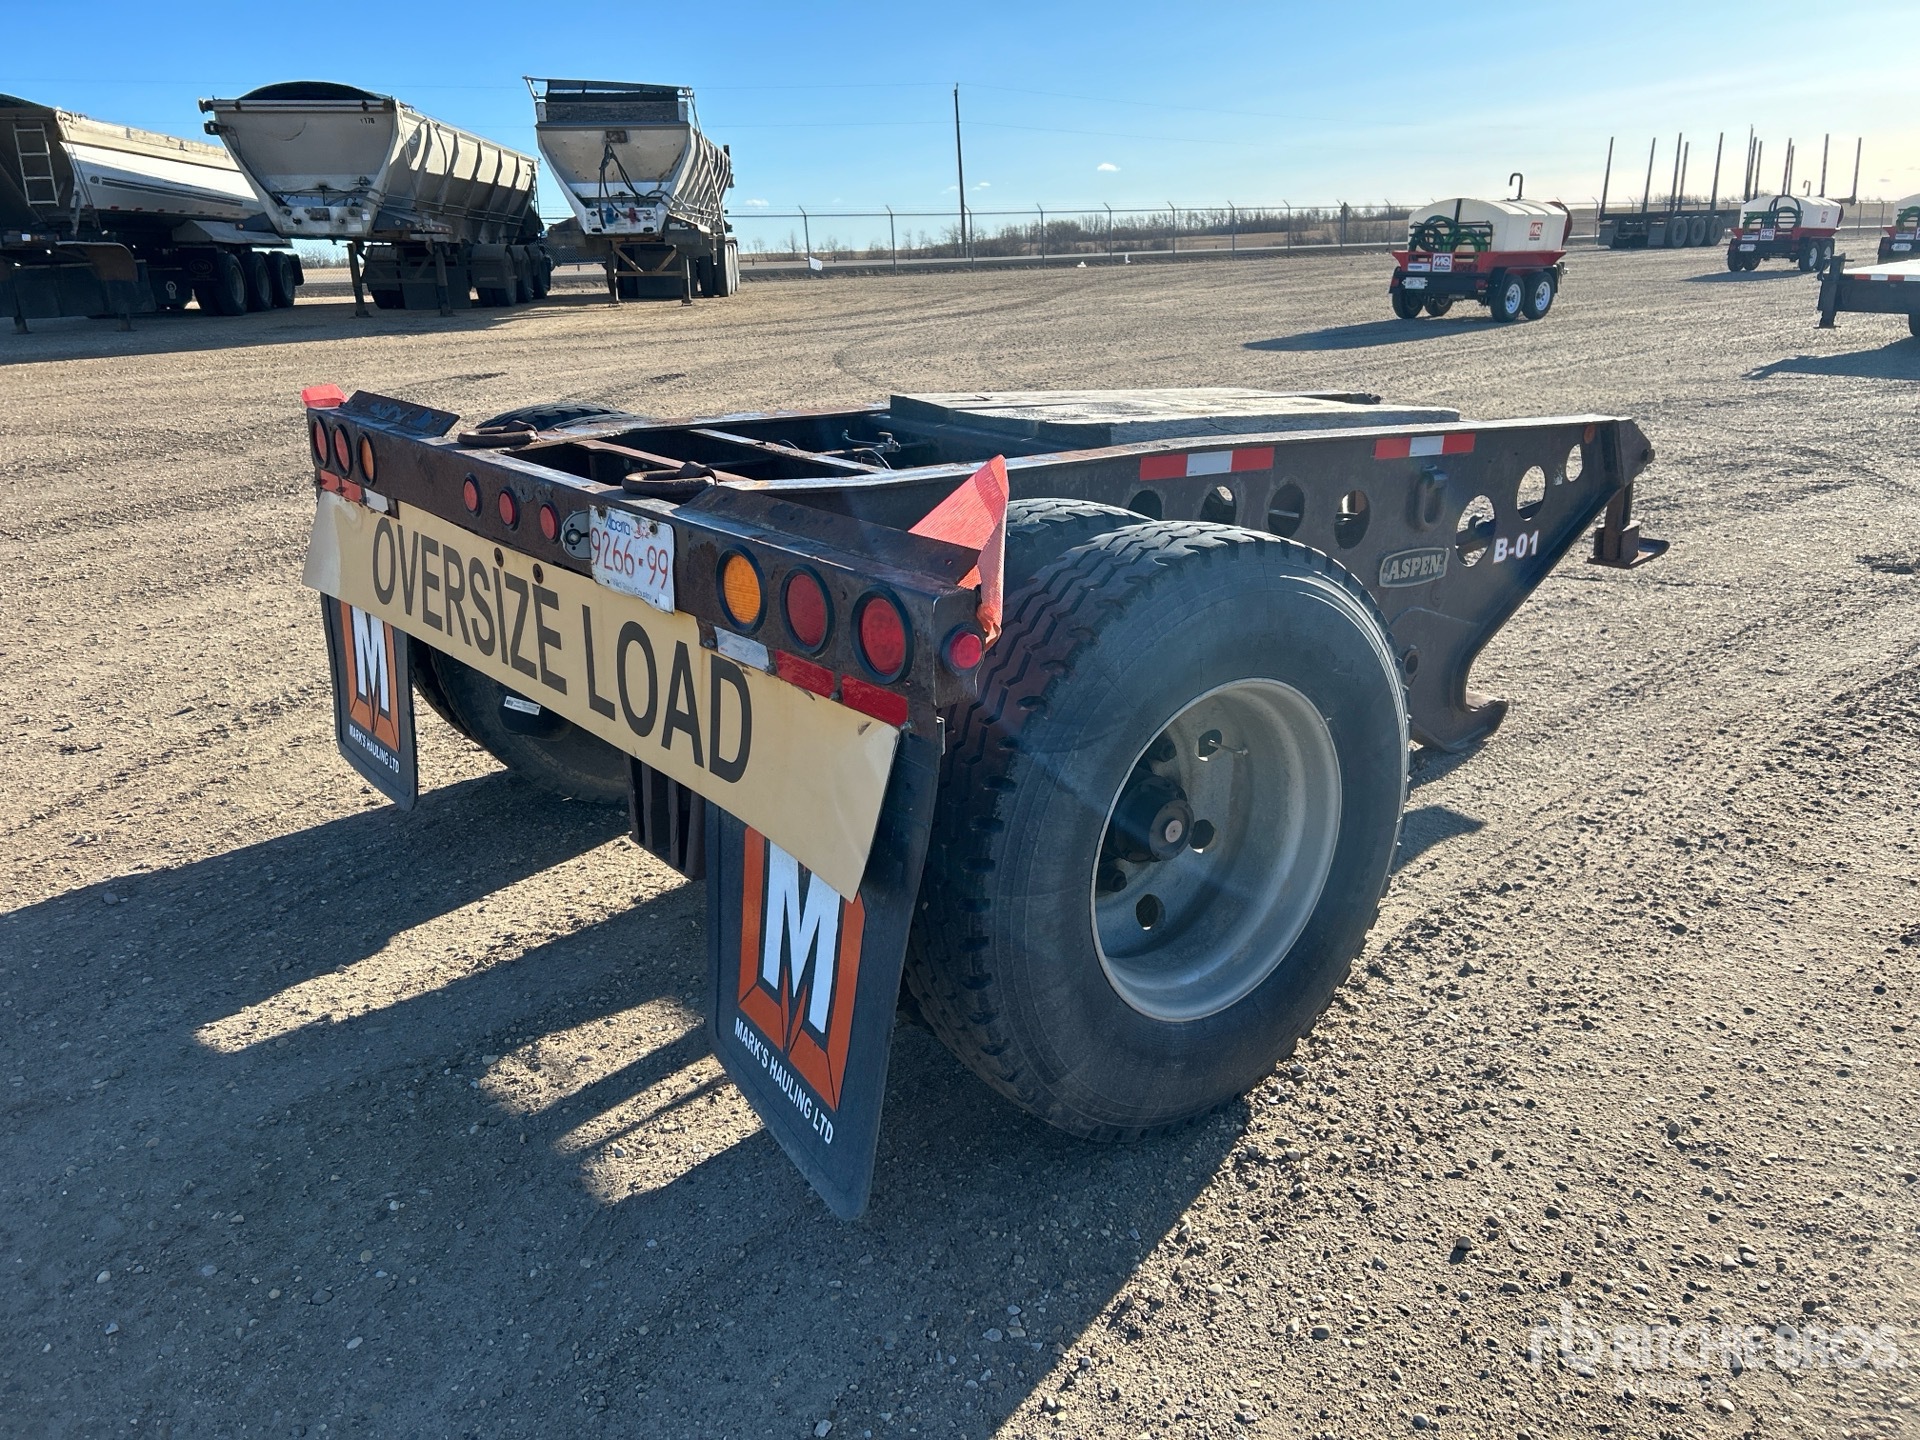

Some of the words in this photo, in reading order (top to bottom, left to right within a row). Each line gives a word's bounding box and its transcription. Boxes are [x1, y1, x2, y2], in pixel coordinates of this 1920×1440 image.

[1388, 554, 1442, 581] ASPEN
[1493, 530, 1539, 564] B-01
[352, 606, 390, 713] M
[373, 517, 568, 696] OVERSIZE
[582, 604, 753, 784] LOAD
[349, 723, 367, 748] MARK'S
[366, 737, 389, 766] HAULING
[389, 755, 400, 774] LTD
[763, 840, 841, 1034] M
[734, 1017, 770, 1069] MARK'S
[769, 1056, 813, 1120] HAULING
[812, 1107, 834, 1145] LTD
